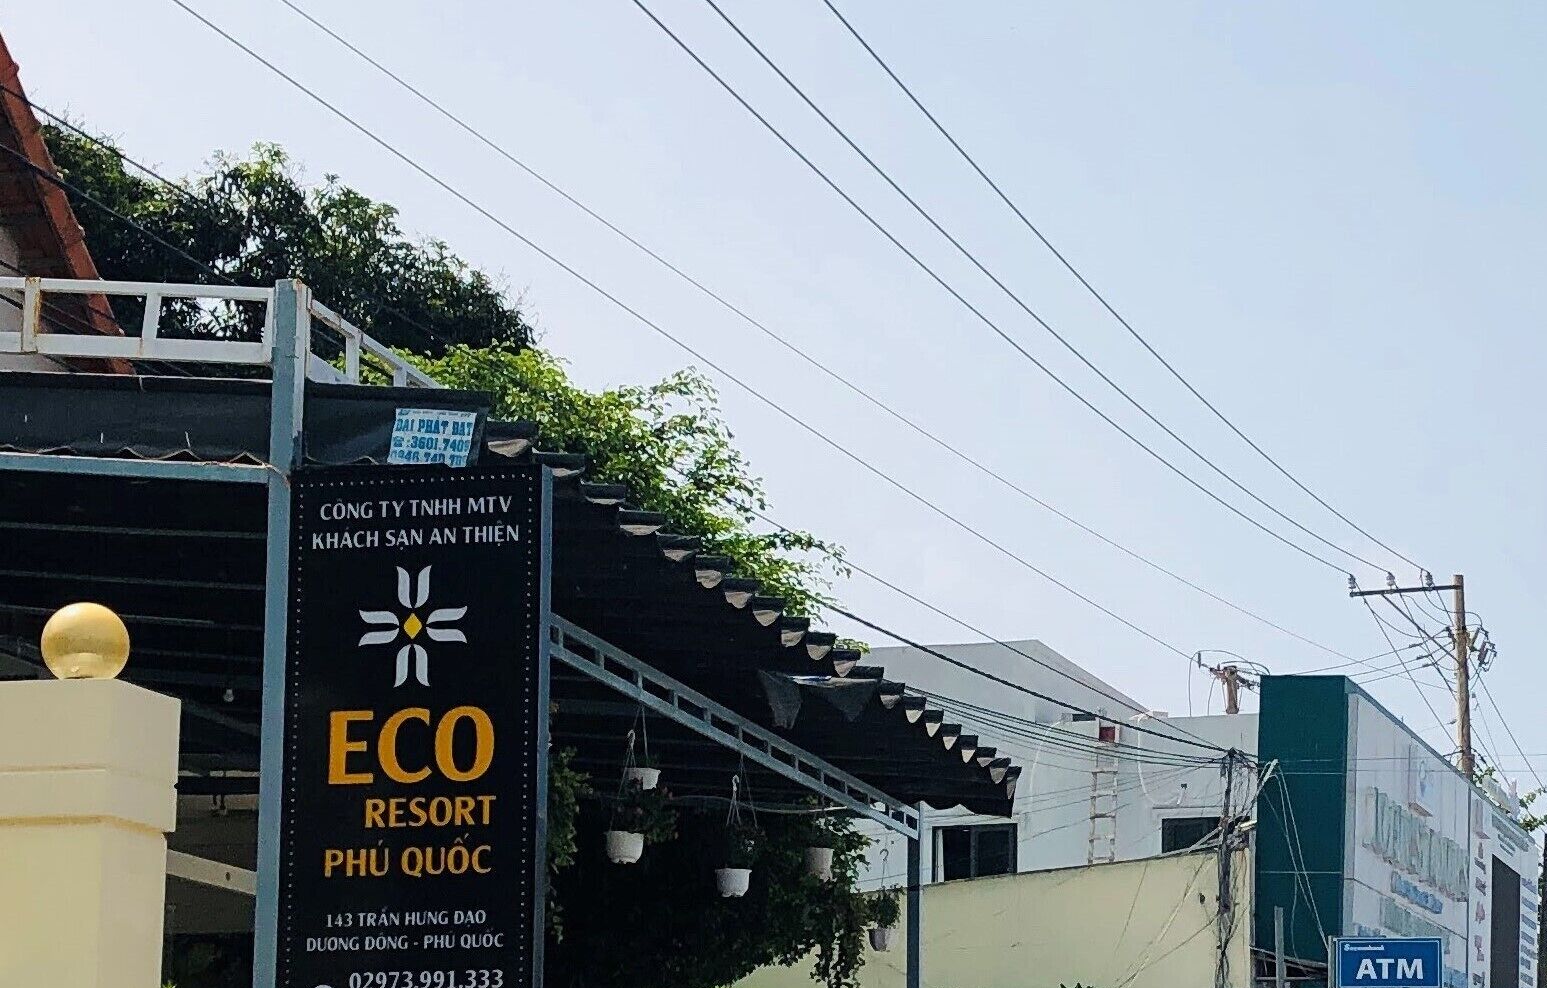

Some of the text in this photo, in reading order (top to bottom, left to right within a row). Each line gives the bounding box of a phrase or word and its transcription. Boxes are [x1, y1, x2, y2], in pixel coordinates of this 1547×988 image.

[320, 496, 512, 520] CÔNG TY TNHH MTV
[312, 520, 519, 551] KHÁCH SẠN AN THIỆN
[328, 706, 495, 785] ECO
[365, 796, 497, 828] RESORT
[325, 833, 492, 878] PHÚ QUỐC
[326, 913, 353, 928] 143
[358, 906, 400, 927] TRẦN
[424, 930, 455, 949] PHÚ
[460, 927, 504, 949] QUỐC
[1356, 958, 1424, 980] ATM
